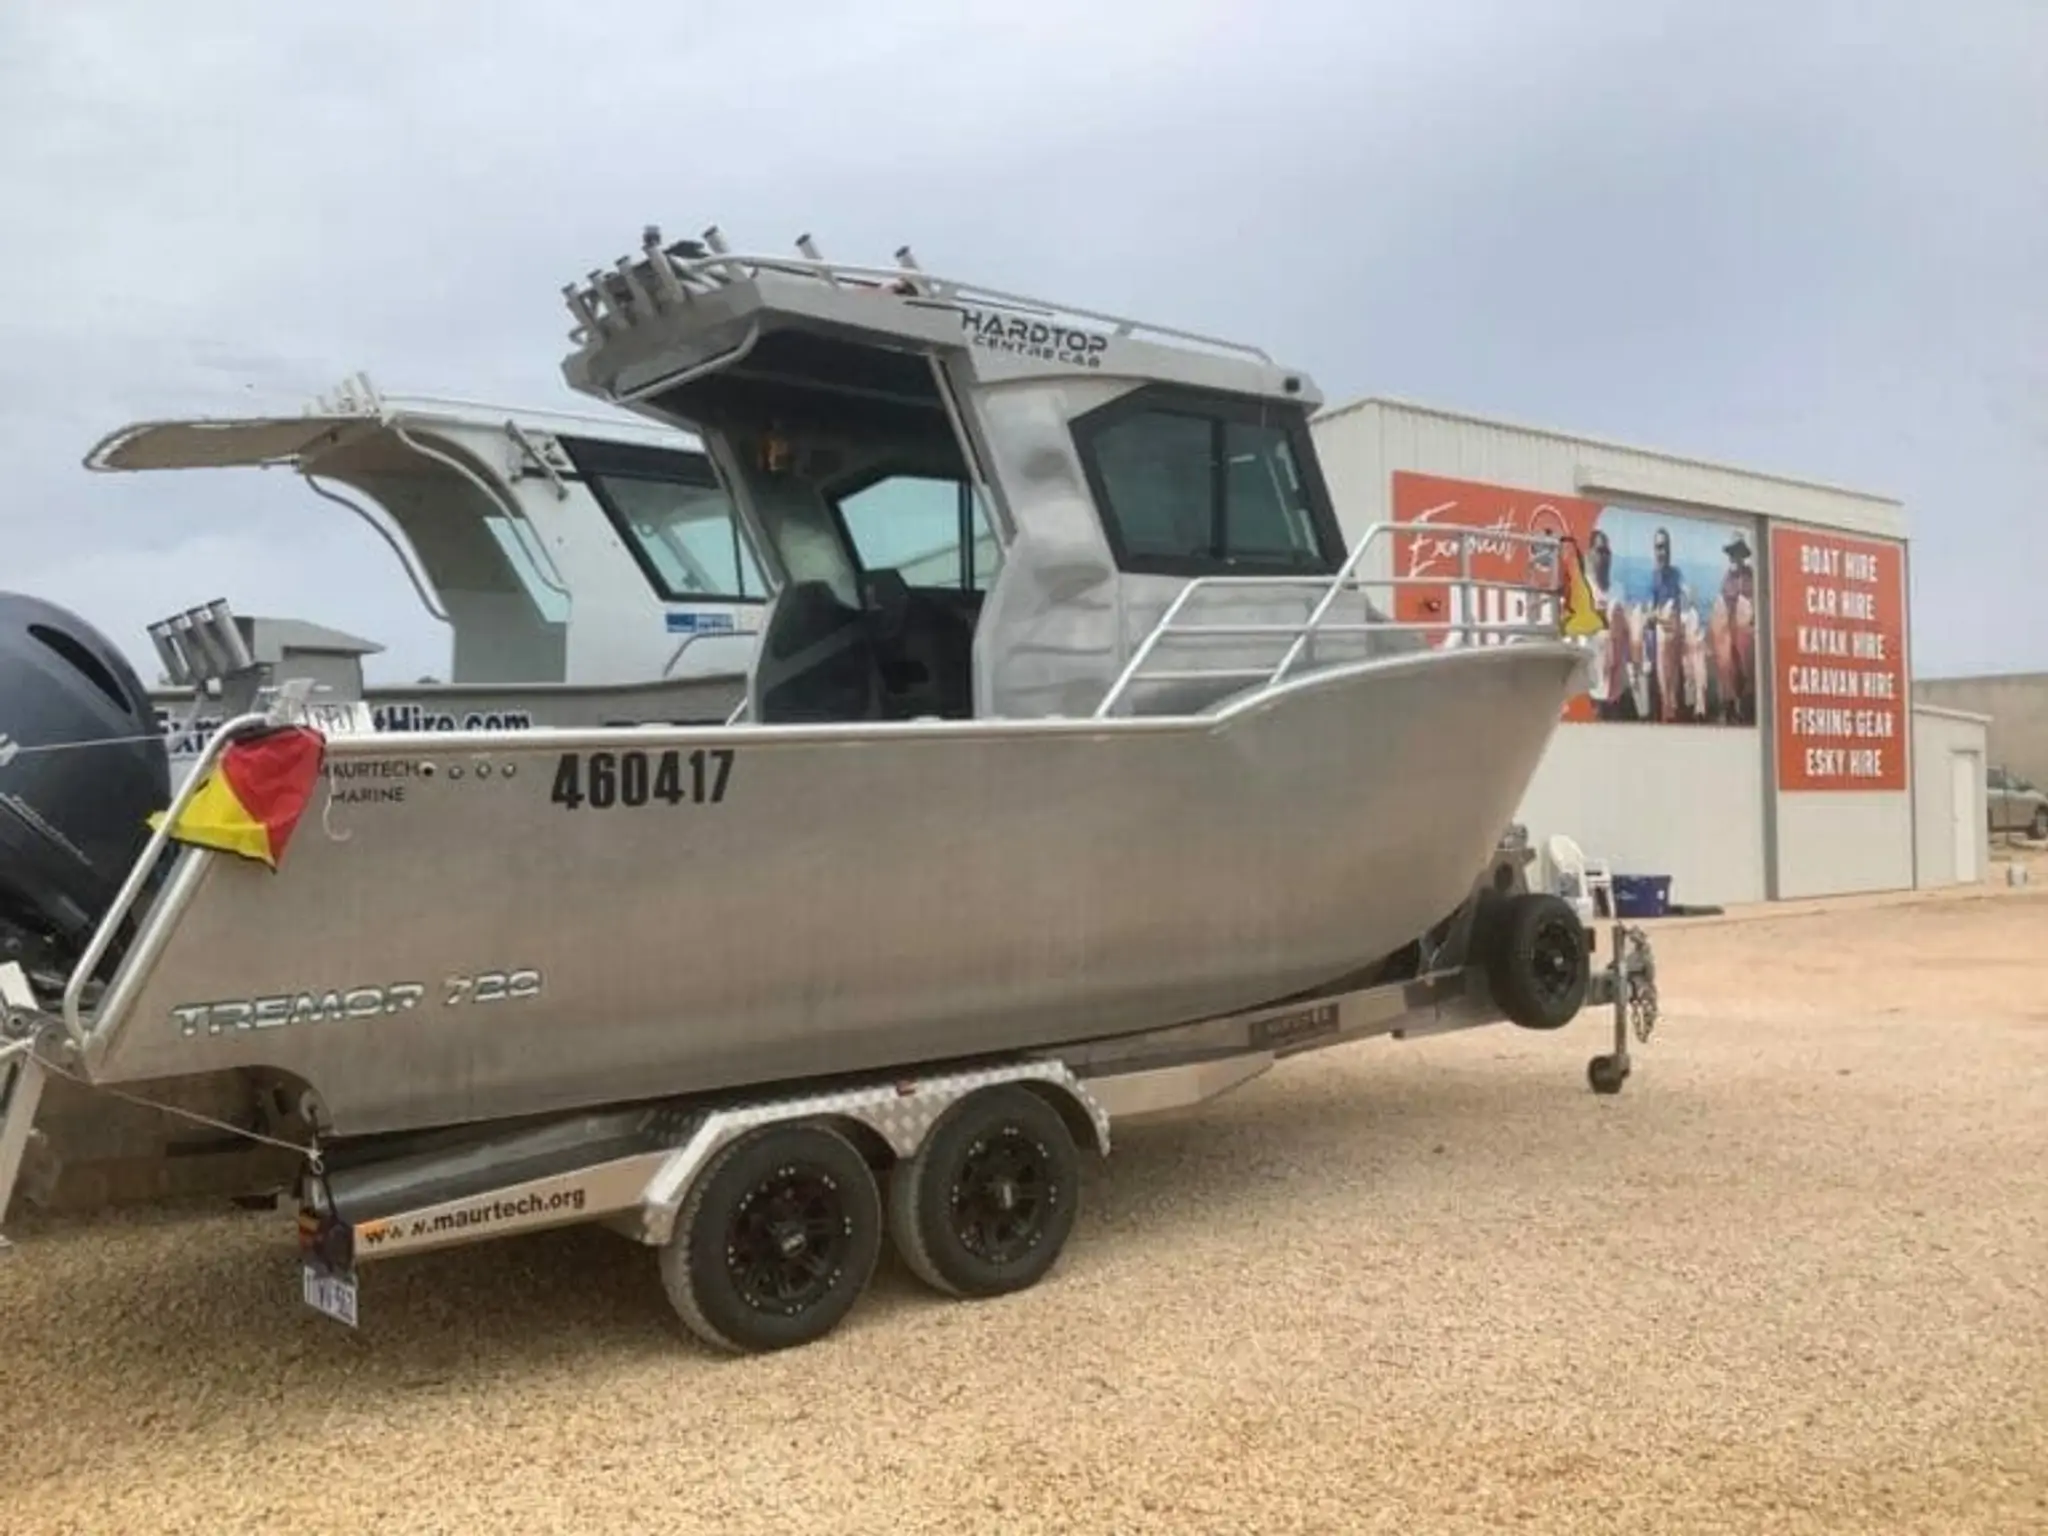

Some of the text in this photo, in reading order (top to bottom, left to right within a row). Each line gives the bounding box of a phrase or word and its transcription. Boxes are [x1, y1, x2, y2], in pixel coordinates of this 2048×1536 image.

[961, 309, 1108, 353] HARDTOP
[1801, 545, 1878, 582] BOAT HIRE
[1807, 586, 1876, 620] CAR HIRE
[1799, 626, 1886, 660] KAYAK HIRE
[1789, 665, 1895, 699] CARAVAN HIRE
[1792, 706, 1894, 738] FISHING GEAR
[551, 749, 735, 810] 460417
[1806, 748, 1882, 777] ESKY HIRE
[331, 786, 405, 804] MARINE
[170, 982, 425, 1037] TREMOR
